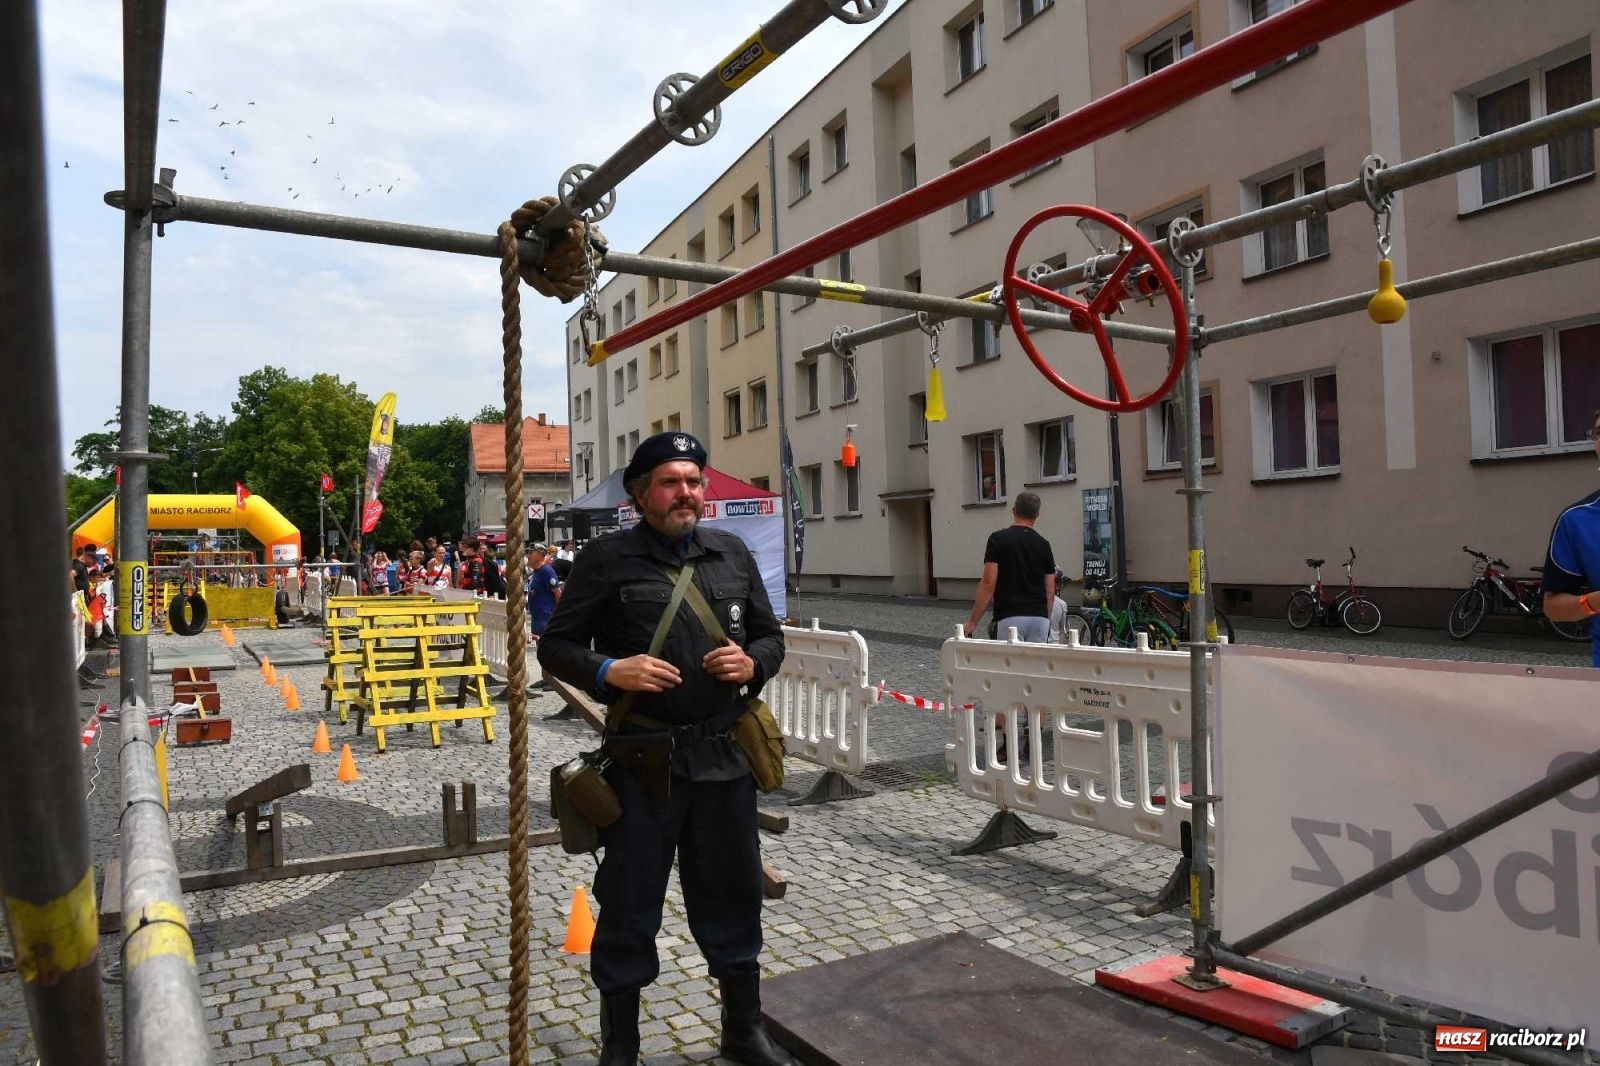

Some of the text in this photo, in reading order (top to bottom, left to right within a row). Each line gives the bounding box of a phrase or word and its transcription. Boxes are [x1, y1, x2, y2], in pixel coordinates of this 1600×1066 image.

[721, 43, 763, 81] ERIGO
[1084, 495, 1108, 504] FITNESS
[149, 505, 233, 516] MIASTO RACIBÓRZ
[727, 501, 773, 516] nowiny.pl
[1086, 503, 1107, 512] WORLD
[1086, 559, 1106, 568] TRENUJ
[133, 565, 144, 631] ERIGO
